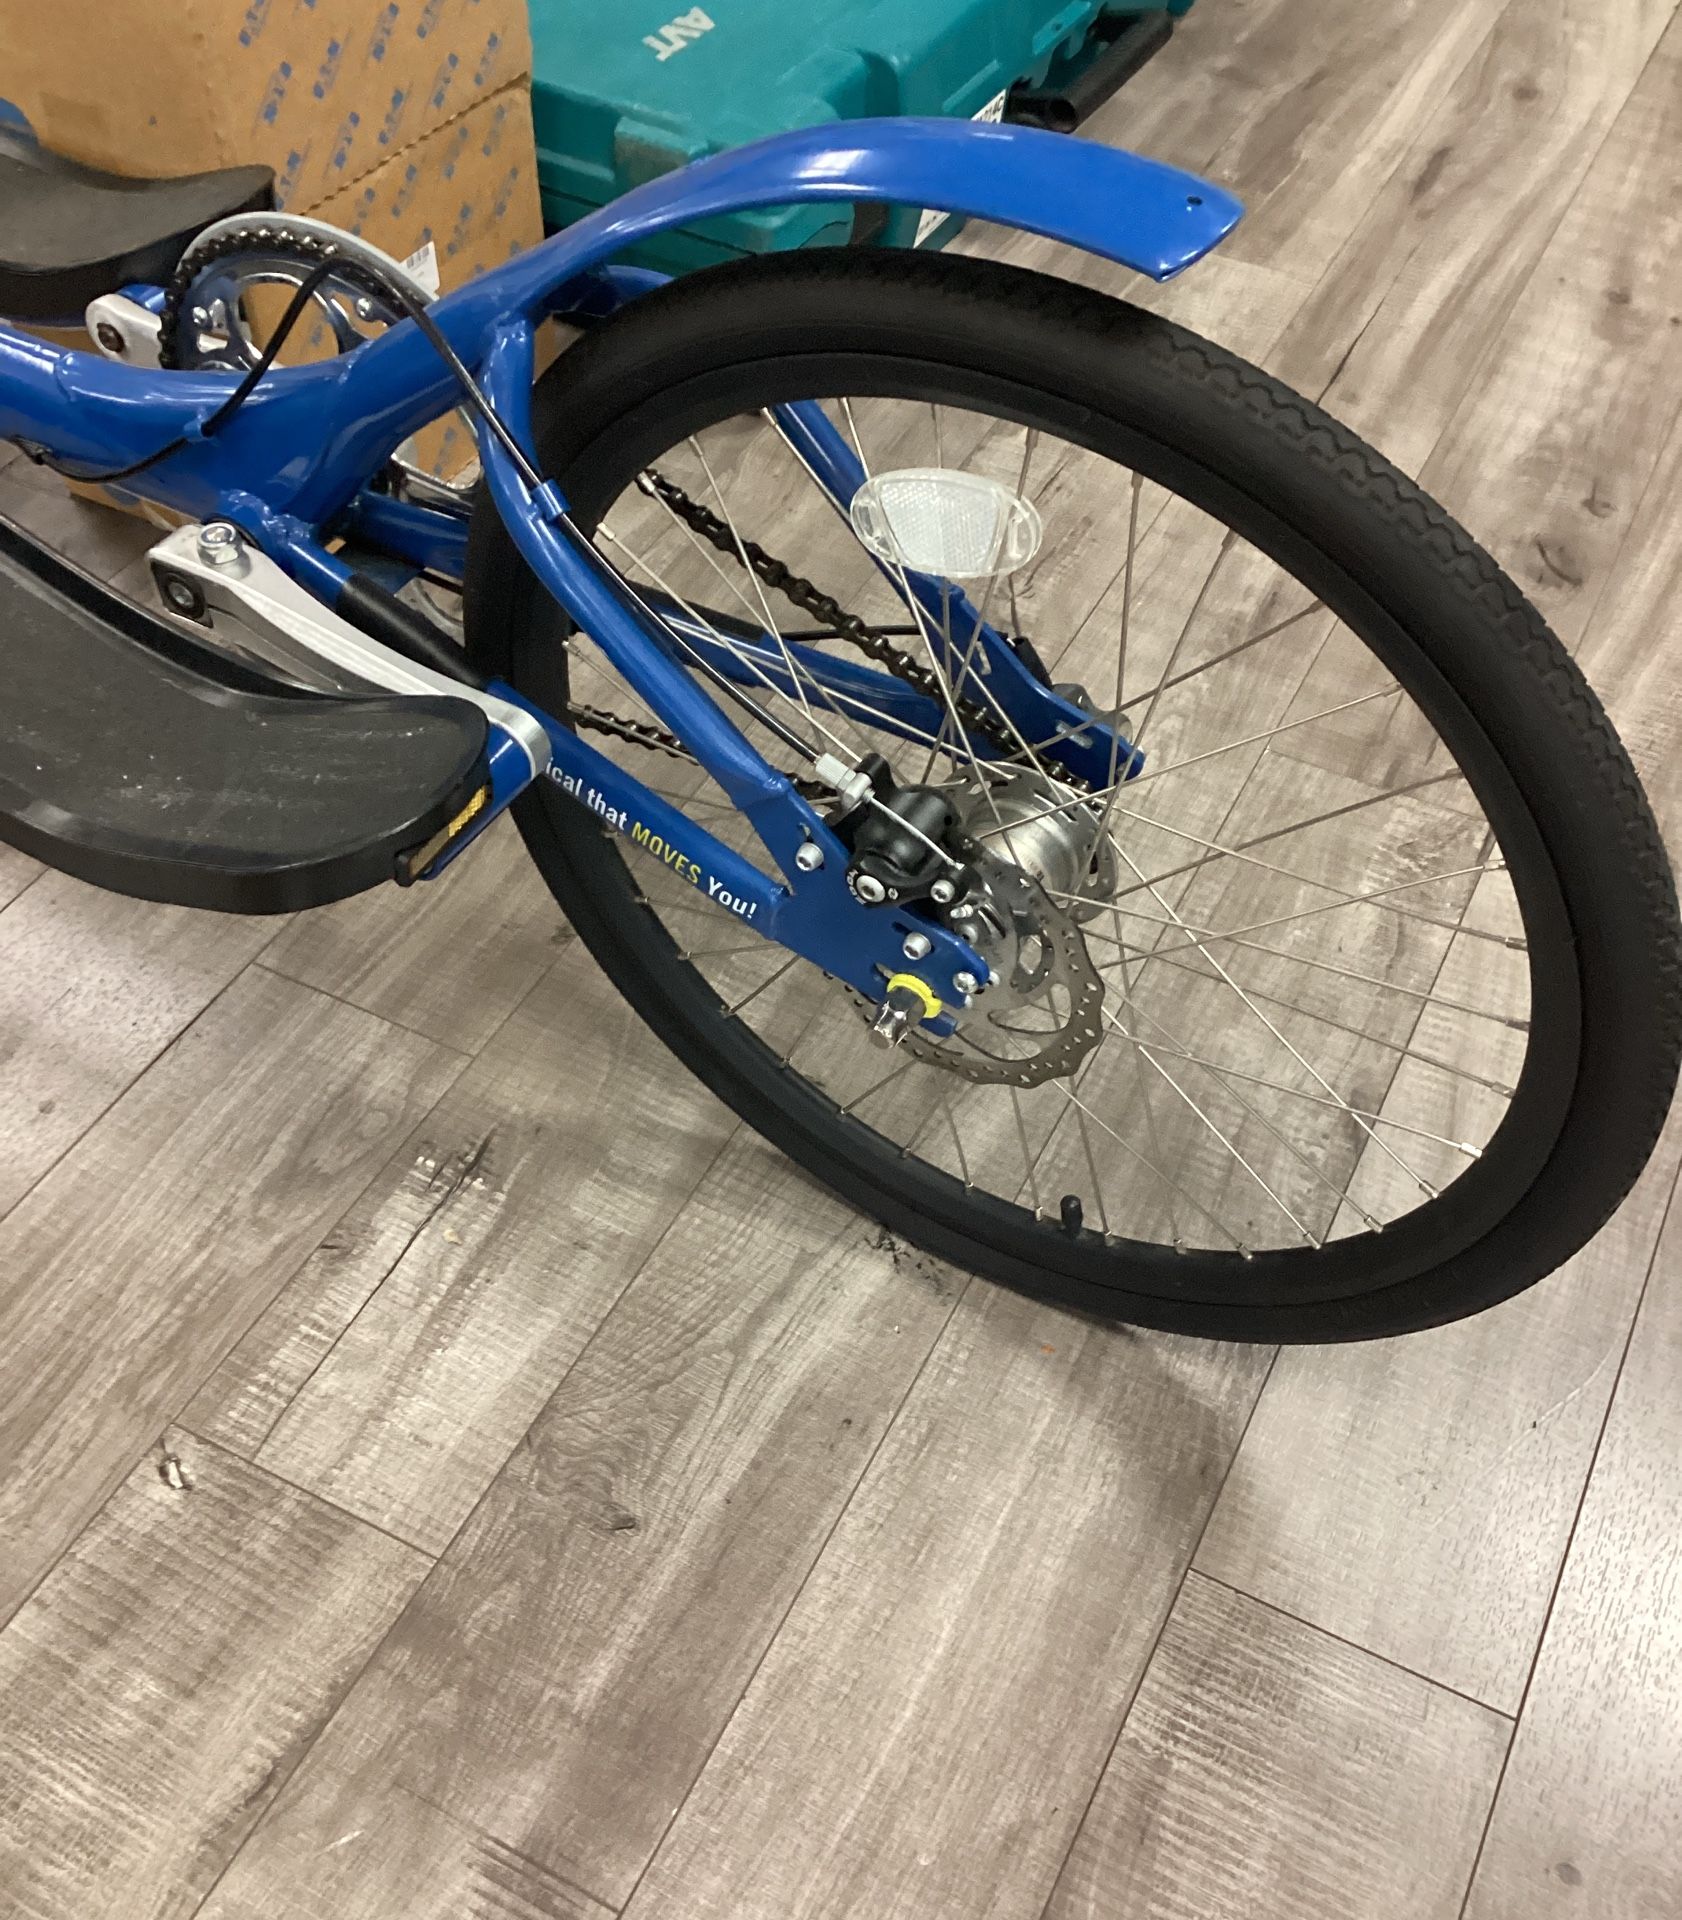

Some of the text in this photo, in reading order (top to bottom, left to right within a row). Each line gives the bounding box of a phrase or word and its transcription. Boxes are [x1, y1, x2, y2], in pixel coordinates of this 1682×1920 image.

[641, 6, 715, 61] AVT
[587, 788, 627, 830] that
[631, 821, 701, 884] MOVES
[708, 876, 757, 918] You!
